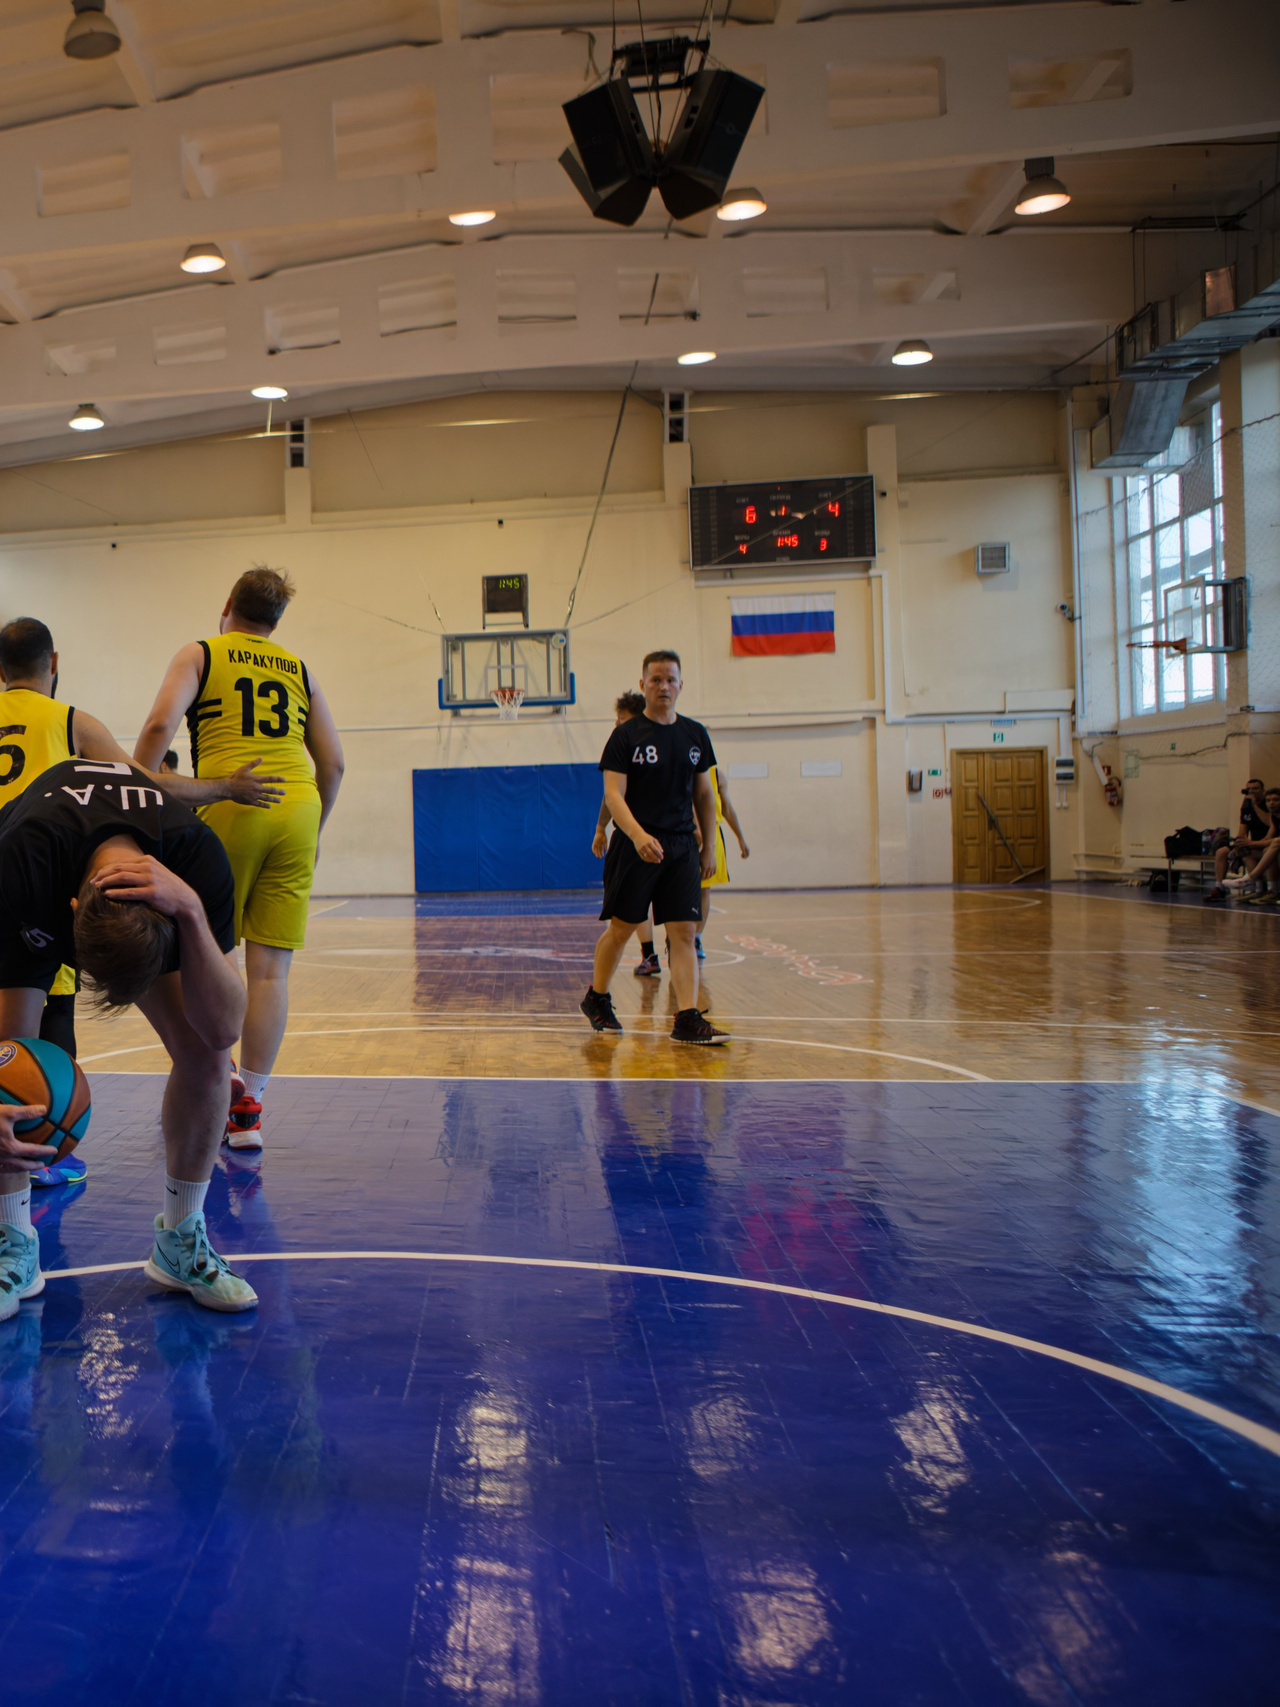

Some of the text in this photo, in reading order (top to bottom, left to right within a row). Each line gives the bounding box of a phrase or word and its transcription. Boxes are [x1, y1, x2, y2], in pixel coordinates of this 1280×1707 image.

[745, 505, 757, 524] 6
[828, 502, 840, 517] 4
[777, 534, 799, 547] 1:45
[820, 538, 828, 551] 3
[739, 543, 747, 554] 4
[498, 577, 520, 589] 1:45
[234, 676, 290, 738] 13
[631, 744, 659, 765] 48
[44, 784, 164, 810] Ш.А.
